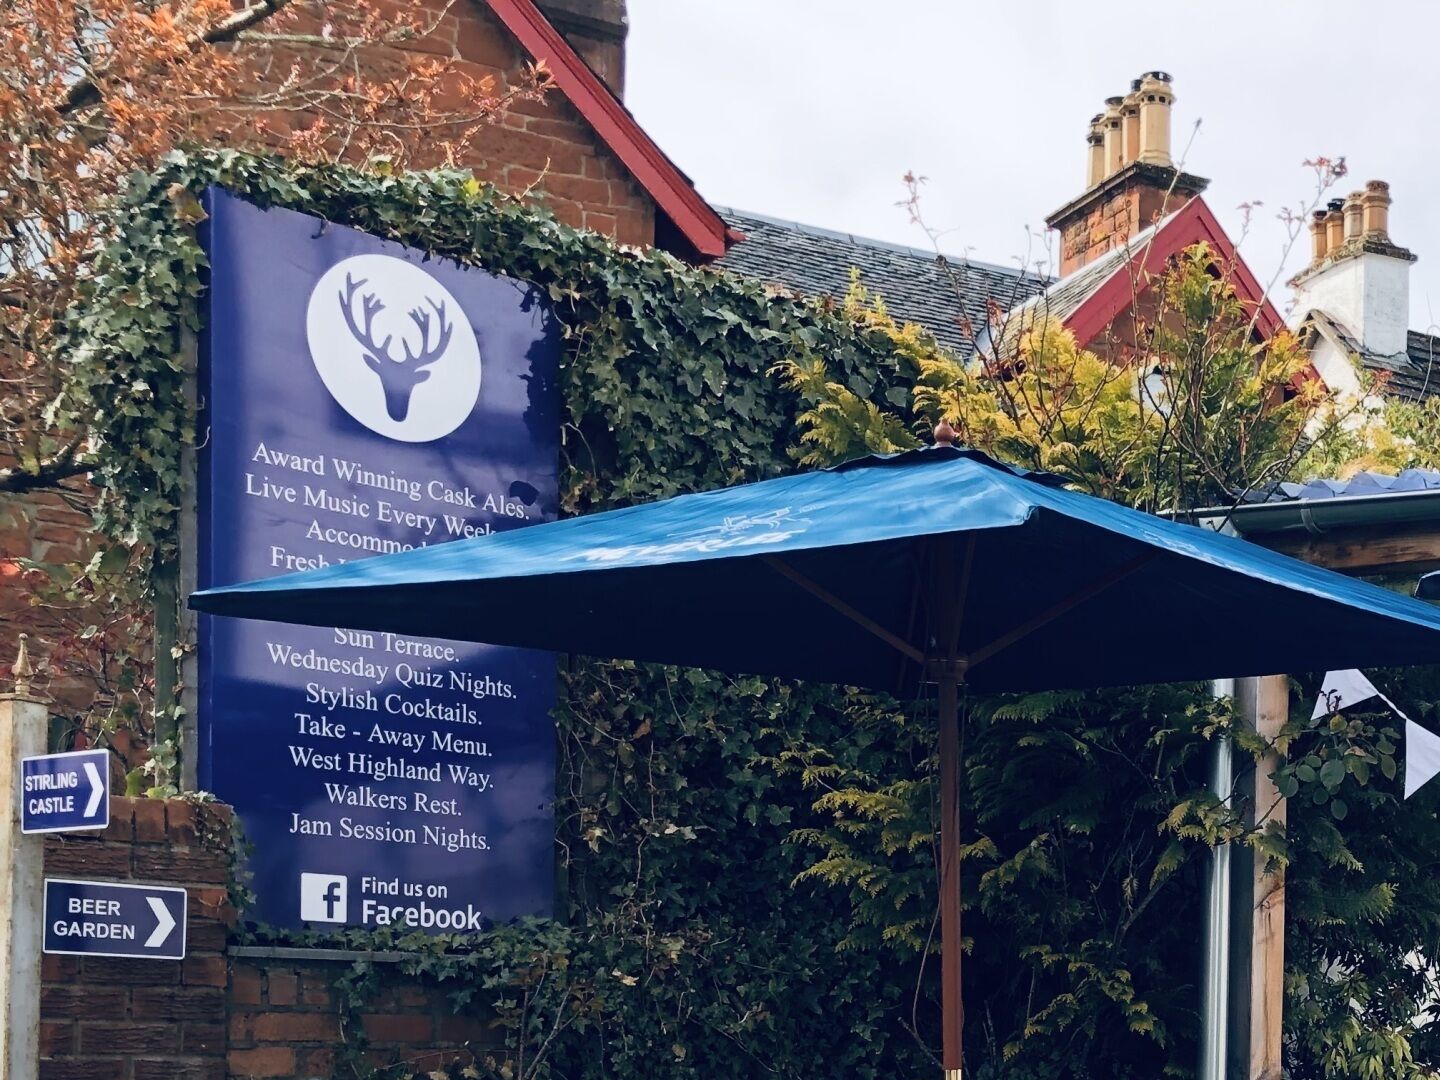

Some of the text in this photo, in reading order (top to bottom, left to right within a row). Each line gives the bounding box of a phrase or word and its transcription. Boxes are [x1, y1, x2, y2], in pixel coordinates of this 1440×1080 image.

[252, 442, 530, 520] Award Winning Cask Ales.
[245, 472, 496, 539] Live Music Every Week
[306, 520, 427, 554] Accommo
[270, 545, 330, 570] Fresh
[334, 627, 460, 662] Sun Terrace.
[267, 643, 517, 699] Wednesday Quiz Nights.
[306, 682, 482, 725] Stylish Cocktails.
[294, 713, 346, 738] Take
[368, 723, 425, 753] Away
[432, 731, 493, 757] Menu.
[25, 772, 77, 791] STIRLING
[288, 746, 494, 792] West Highland Way.
[29, 796, 75, 815] CASTLE
[324, 783, 462, 816] Walkers Rest.
[289, 813, 491, 853] Jam Session Nights.
[361, 877, 448, 899] Find us on
[68, 897, 121, 916] BEER
[362, 899, 482, 931] Facebook
[53, 920, 136, 940] GARDEN
